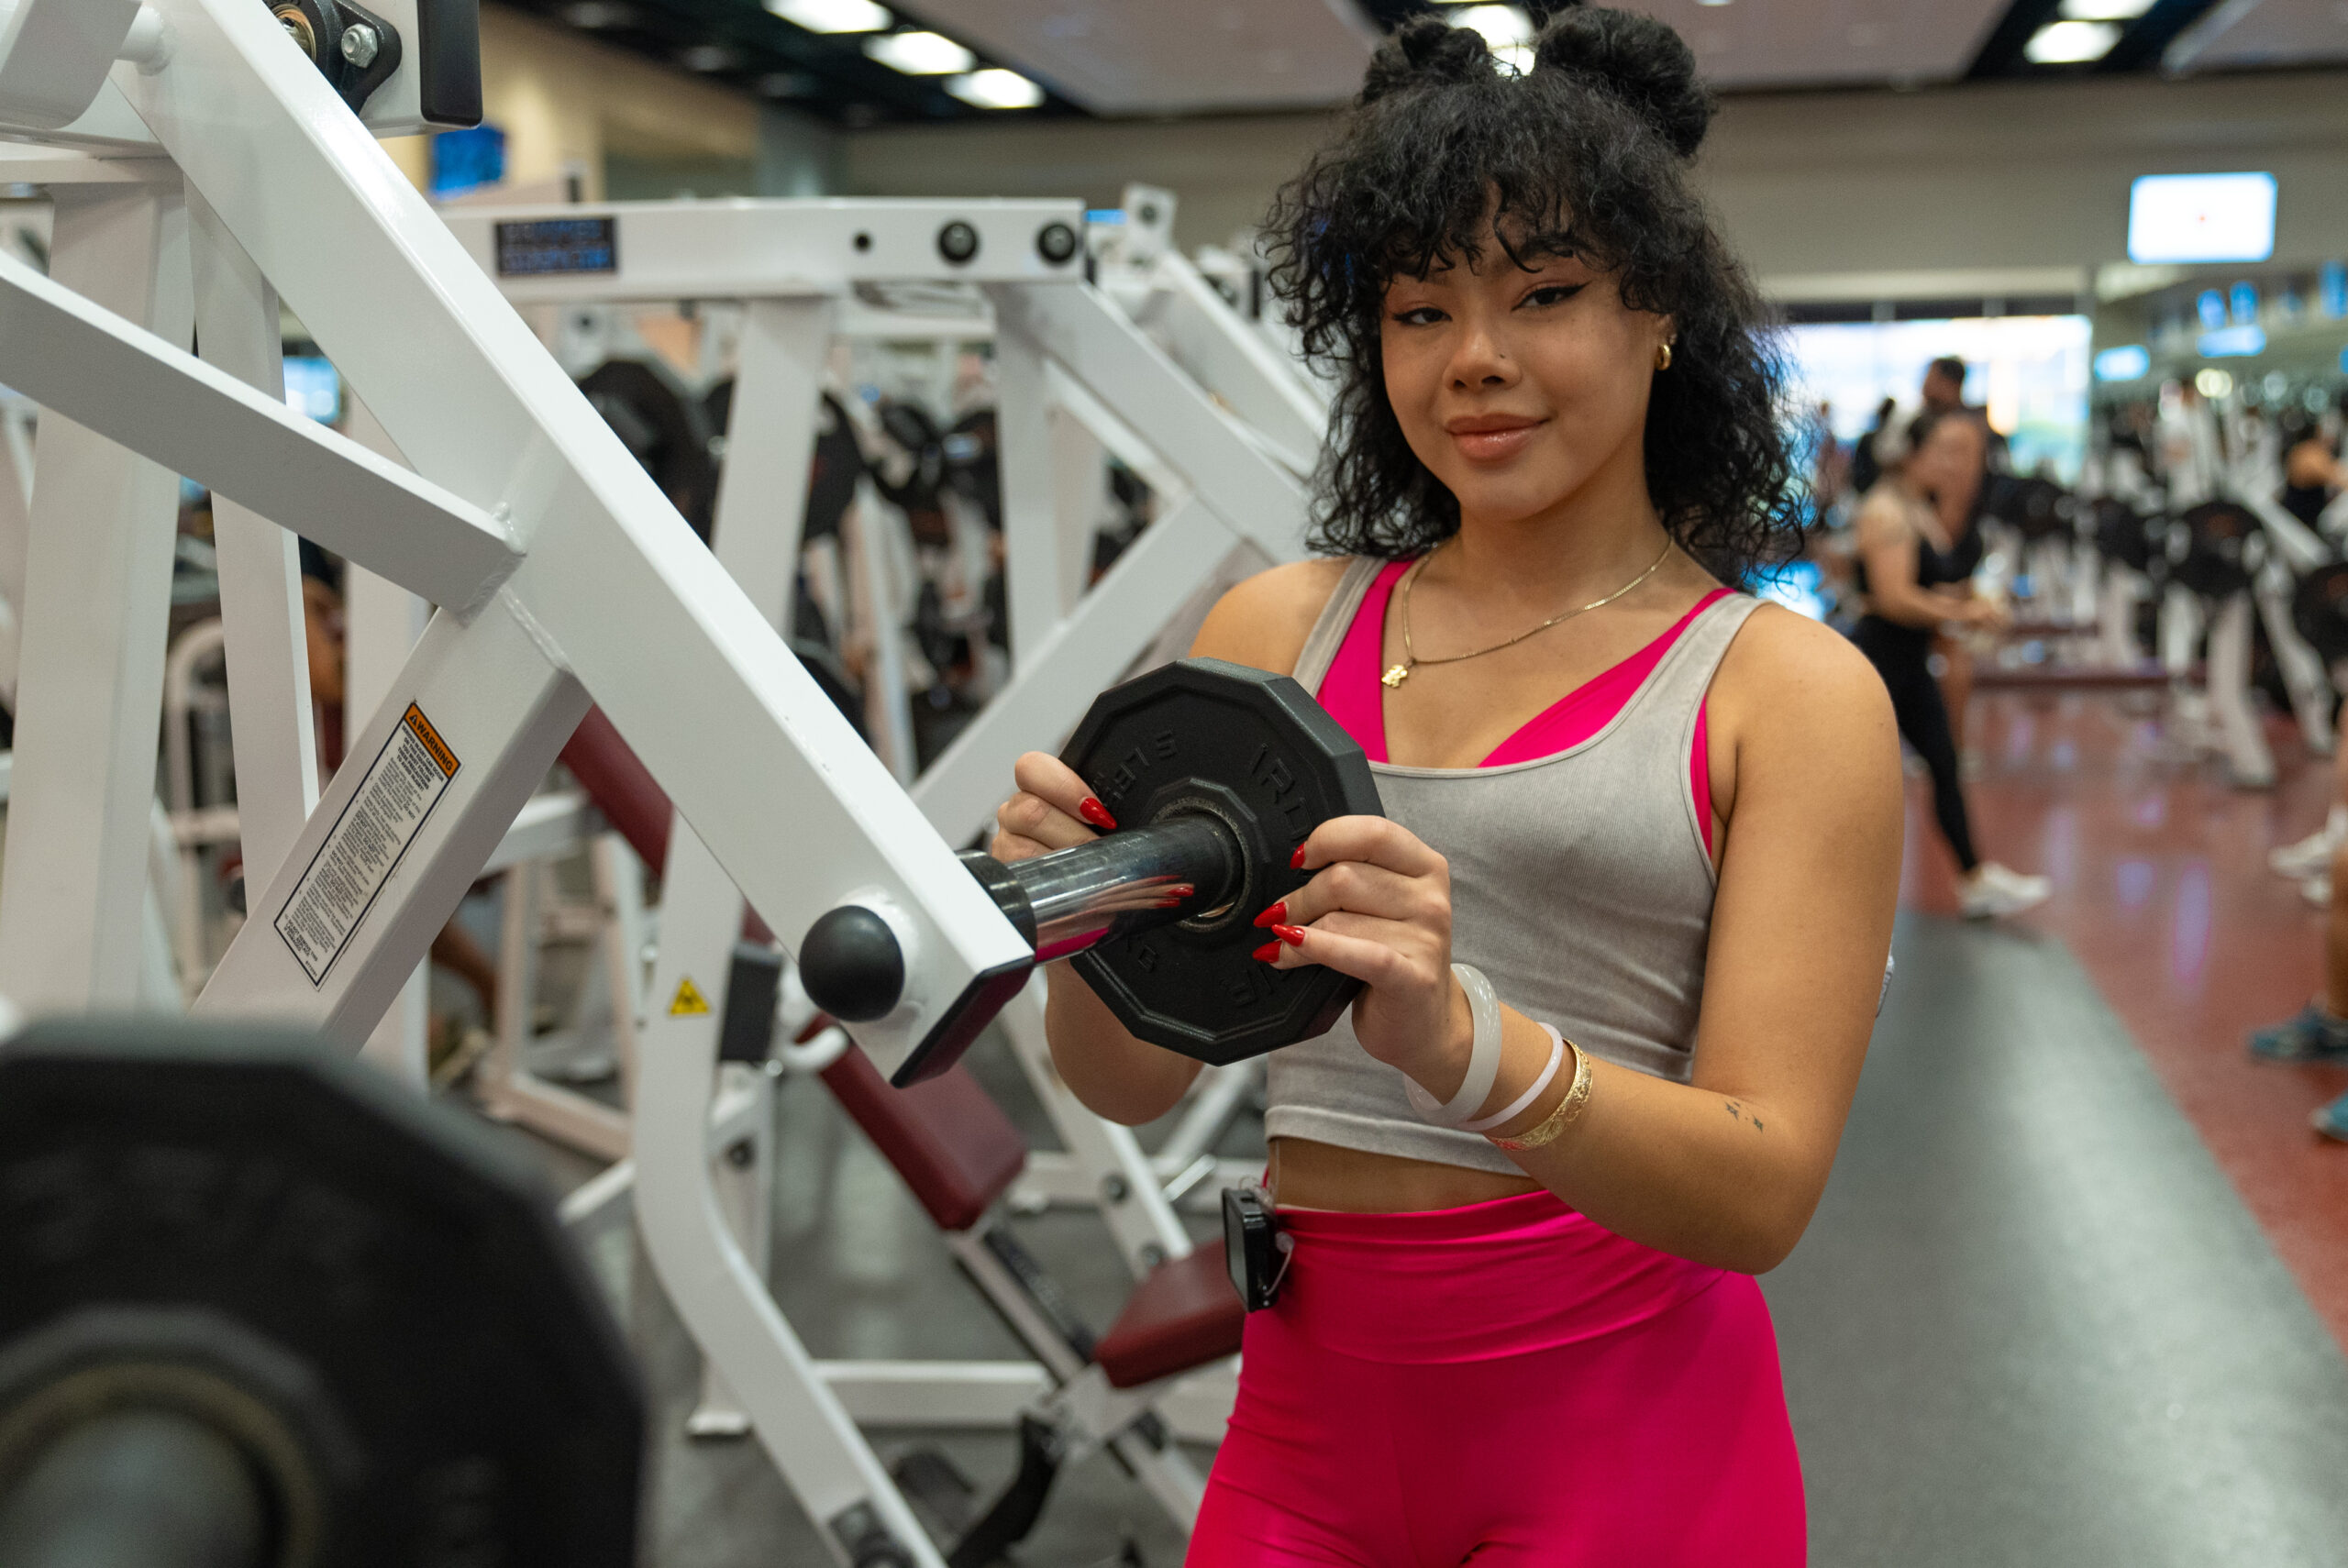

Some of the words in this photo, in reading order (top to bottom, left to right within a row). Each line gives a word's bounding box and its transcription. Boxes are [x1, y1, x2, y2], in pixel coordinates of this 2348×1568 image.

[397, 747, 407, 761] THESE
[407, 760, 428, 790] PRECAUTIONS
[402, 725, 415, 744] SERIOUS
[415, 743, 426, 758] INJURY
[433, 767, 444, 781] OCCUR
[402, 761, 411, 775] AVOID
[409, 753, 418, 766] MUST
[418, 765, 431, 783] FOLLOW
[416, 721, 454, 771] WARNING
[1248, 743, 1318, 844] IRO
